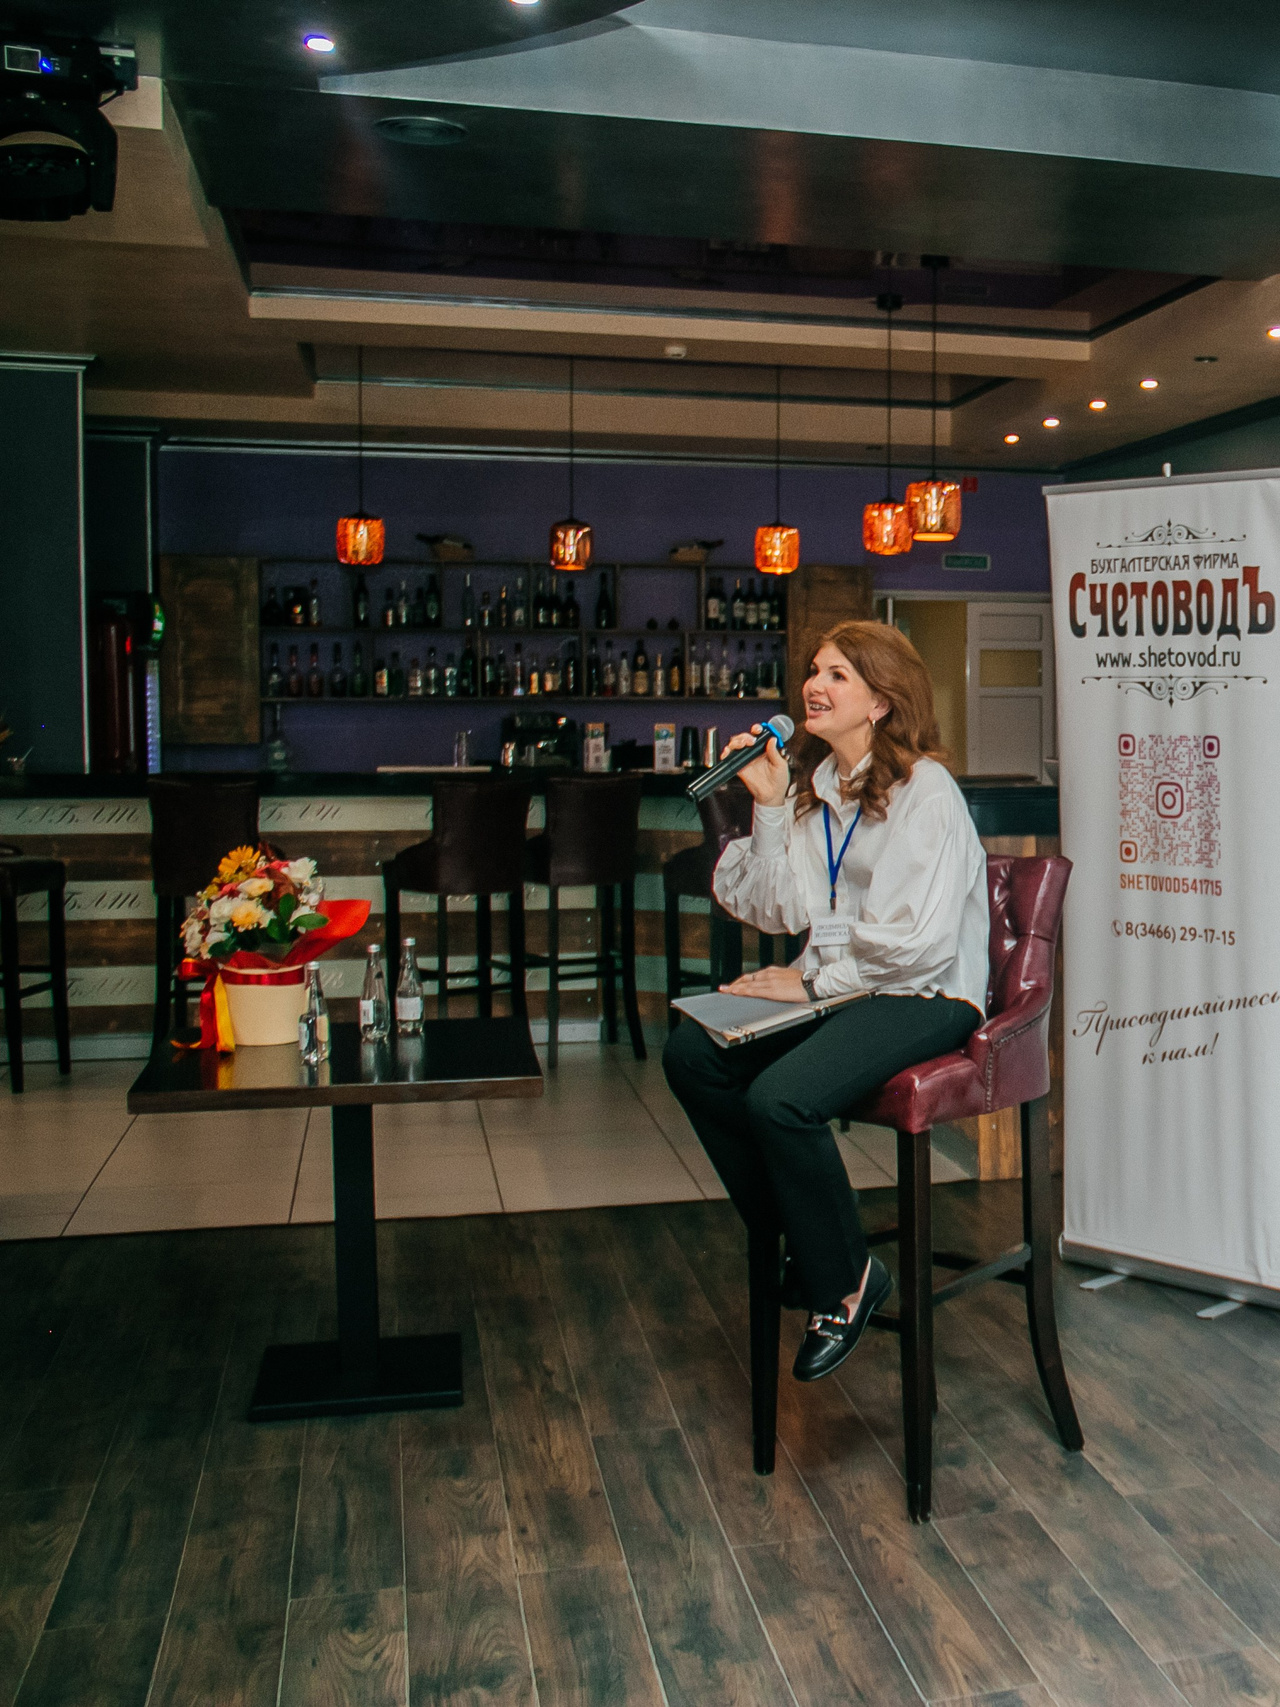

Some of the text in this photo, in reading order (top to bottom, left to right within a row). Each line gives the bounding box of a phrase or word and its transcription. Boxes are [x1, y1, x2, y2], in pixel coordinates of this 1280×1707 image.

[1091, 552, 1239, 575] БУХГАЛТЕРСКАЯ ФИРМА
[1096, 645, 1241, 668] www.shetovod.ru
[1125, 921, 1236, 946] 8(3466) 29-17-15
[1072, 991, 1280, 1056] Присоединяйтесь
[1142, 1032, 1221, 1065] к нам!
